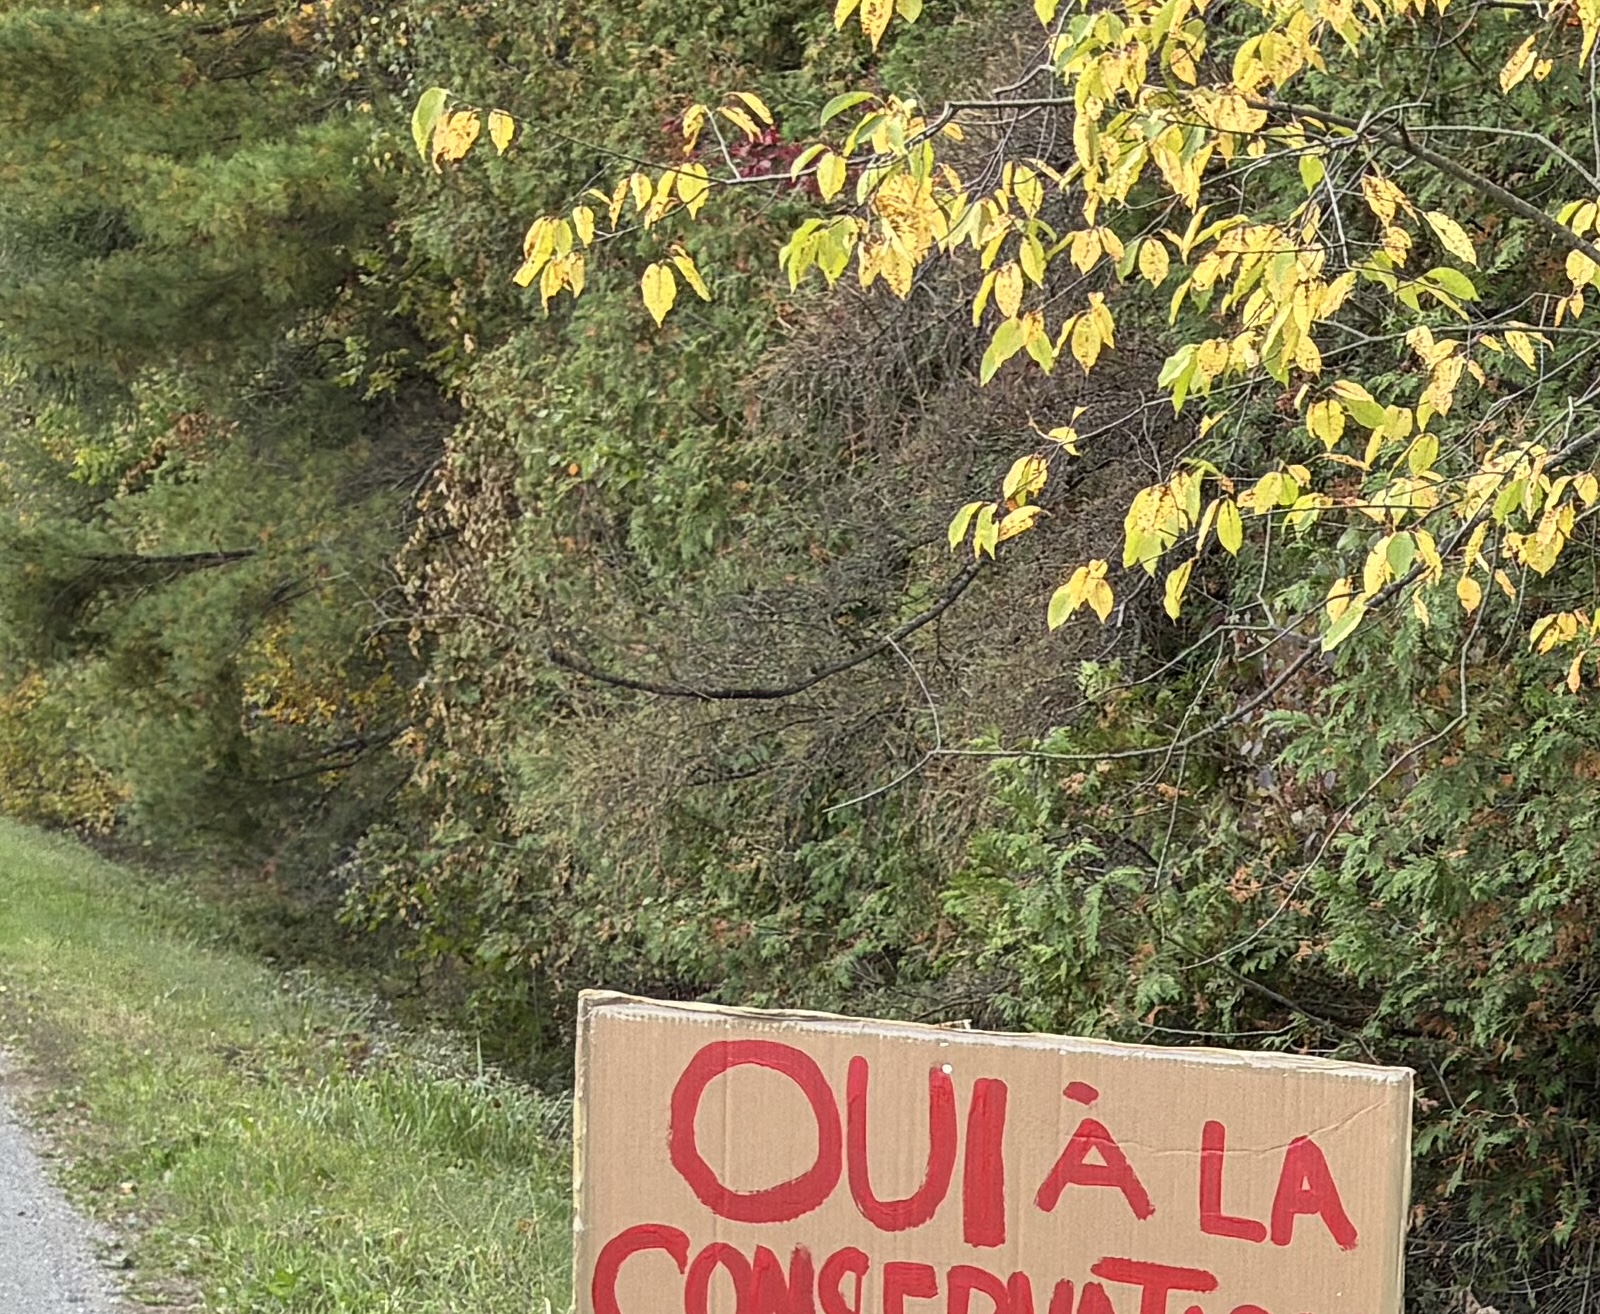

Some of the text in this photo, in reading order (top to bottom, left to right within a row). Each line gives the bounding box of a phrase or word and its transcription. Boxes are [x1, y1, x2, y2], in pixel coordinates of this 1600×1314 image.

[670, 1040, 1359, 1251] OUI À LA
